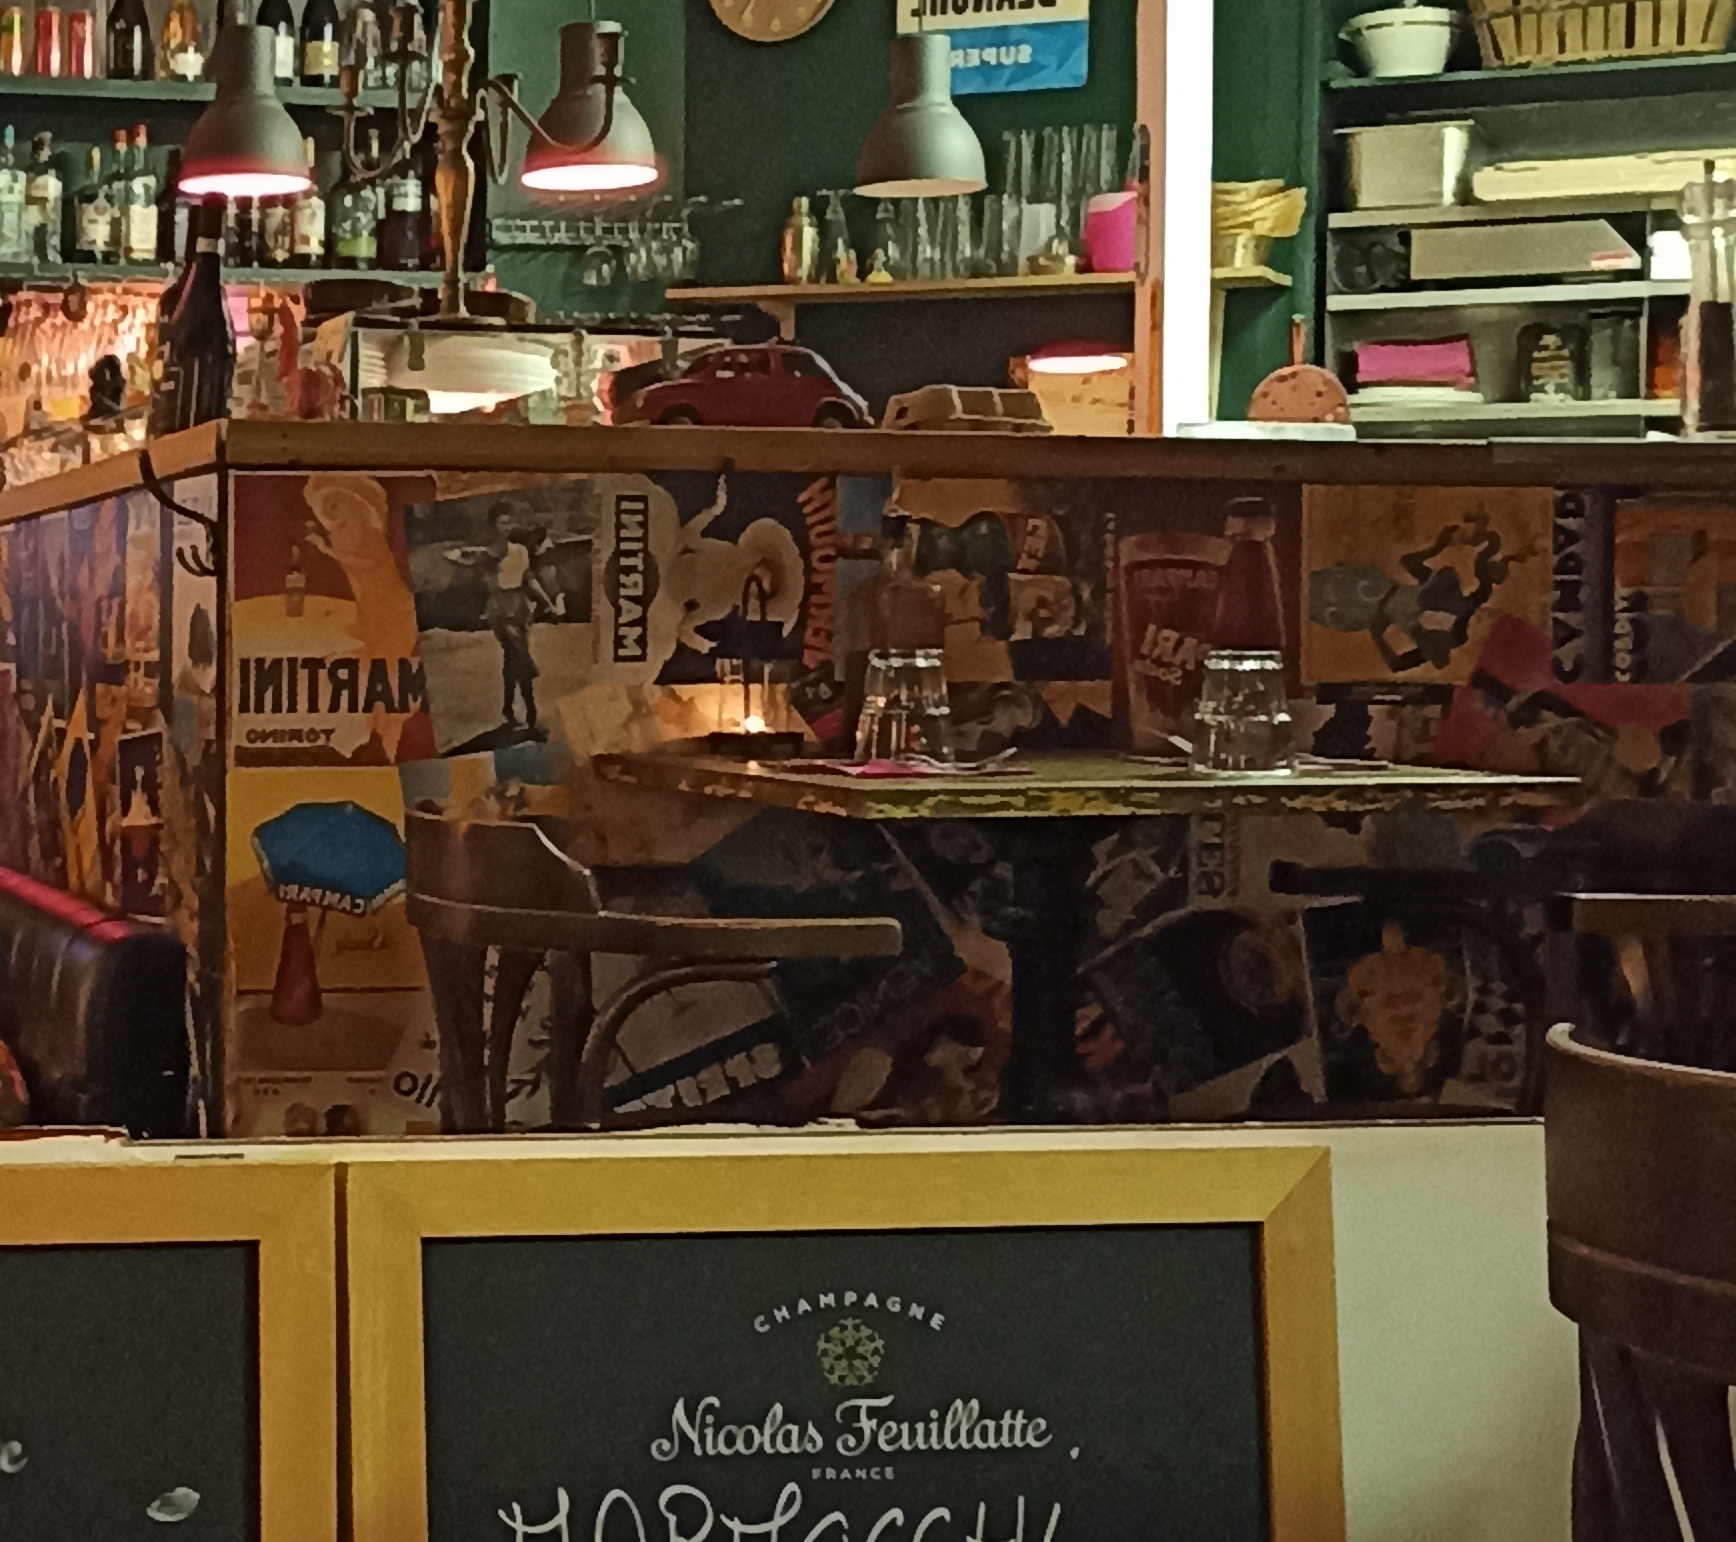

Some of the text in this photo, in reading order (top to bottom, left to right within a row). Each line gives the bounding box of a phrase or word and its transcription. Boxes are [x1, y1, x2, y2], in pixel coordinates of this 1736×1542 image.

[753, 1290, 947, 1335] CHAMPAGNE
[650, 1394, 1053, 1462] Nicolas Feuillatte
[811, 1466, 896, 1481] FRANCE
